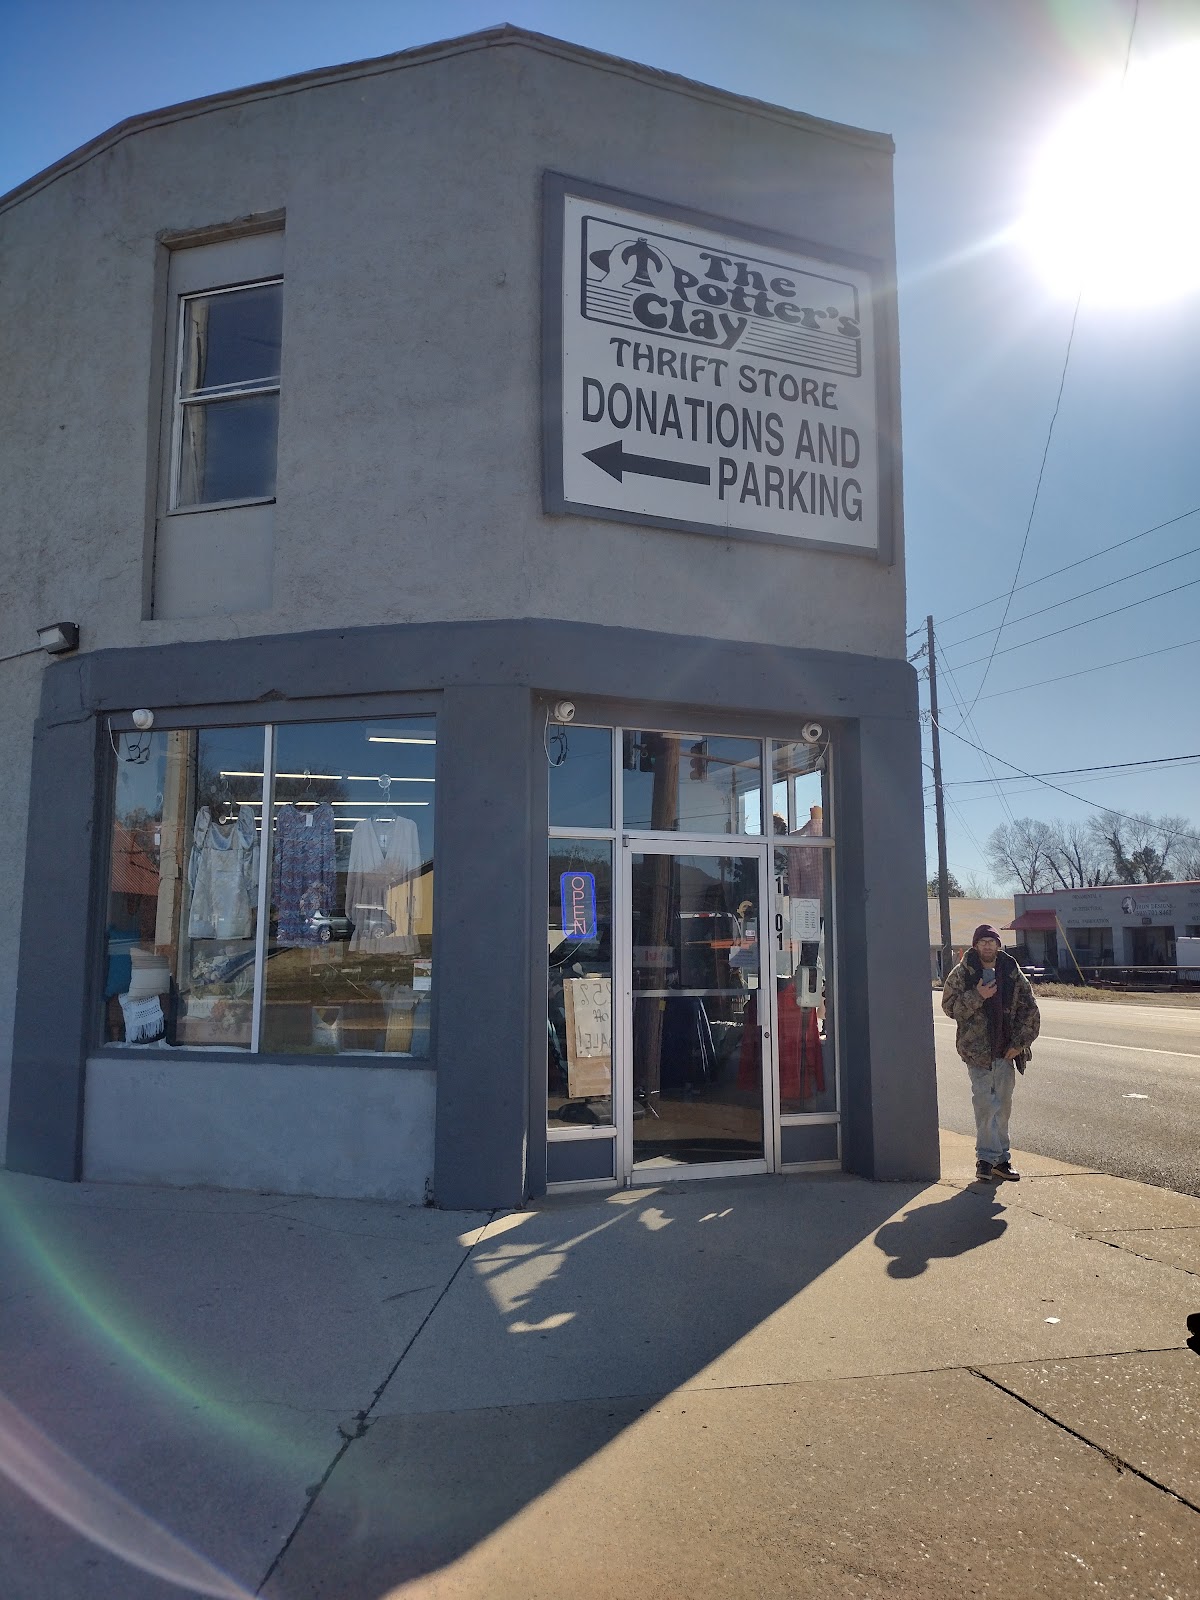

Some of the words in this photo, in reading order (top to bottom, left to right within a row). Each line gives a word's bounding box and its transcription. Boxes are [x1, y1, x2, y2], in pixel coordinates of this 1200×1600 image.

[673, 265, 862, 338] Potter's
[699, 251, 797, 298] The
[632, 292, 748, 350] Clay
[609, 337, 728, 387] THRIFT
[738, 364, 839, 411] STORE
[582, 376, 785, 457] DONATIONS
[795, 418, 861, 470] AND
[718, 456, 863, 522] PARKING
[571, 876, 587, 935] OPEN
